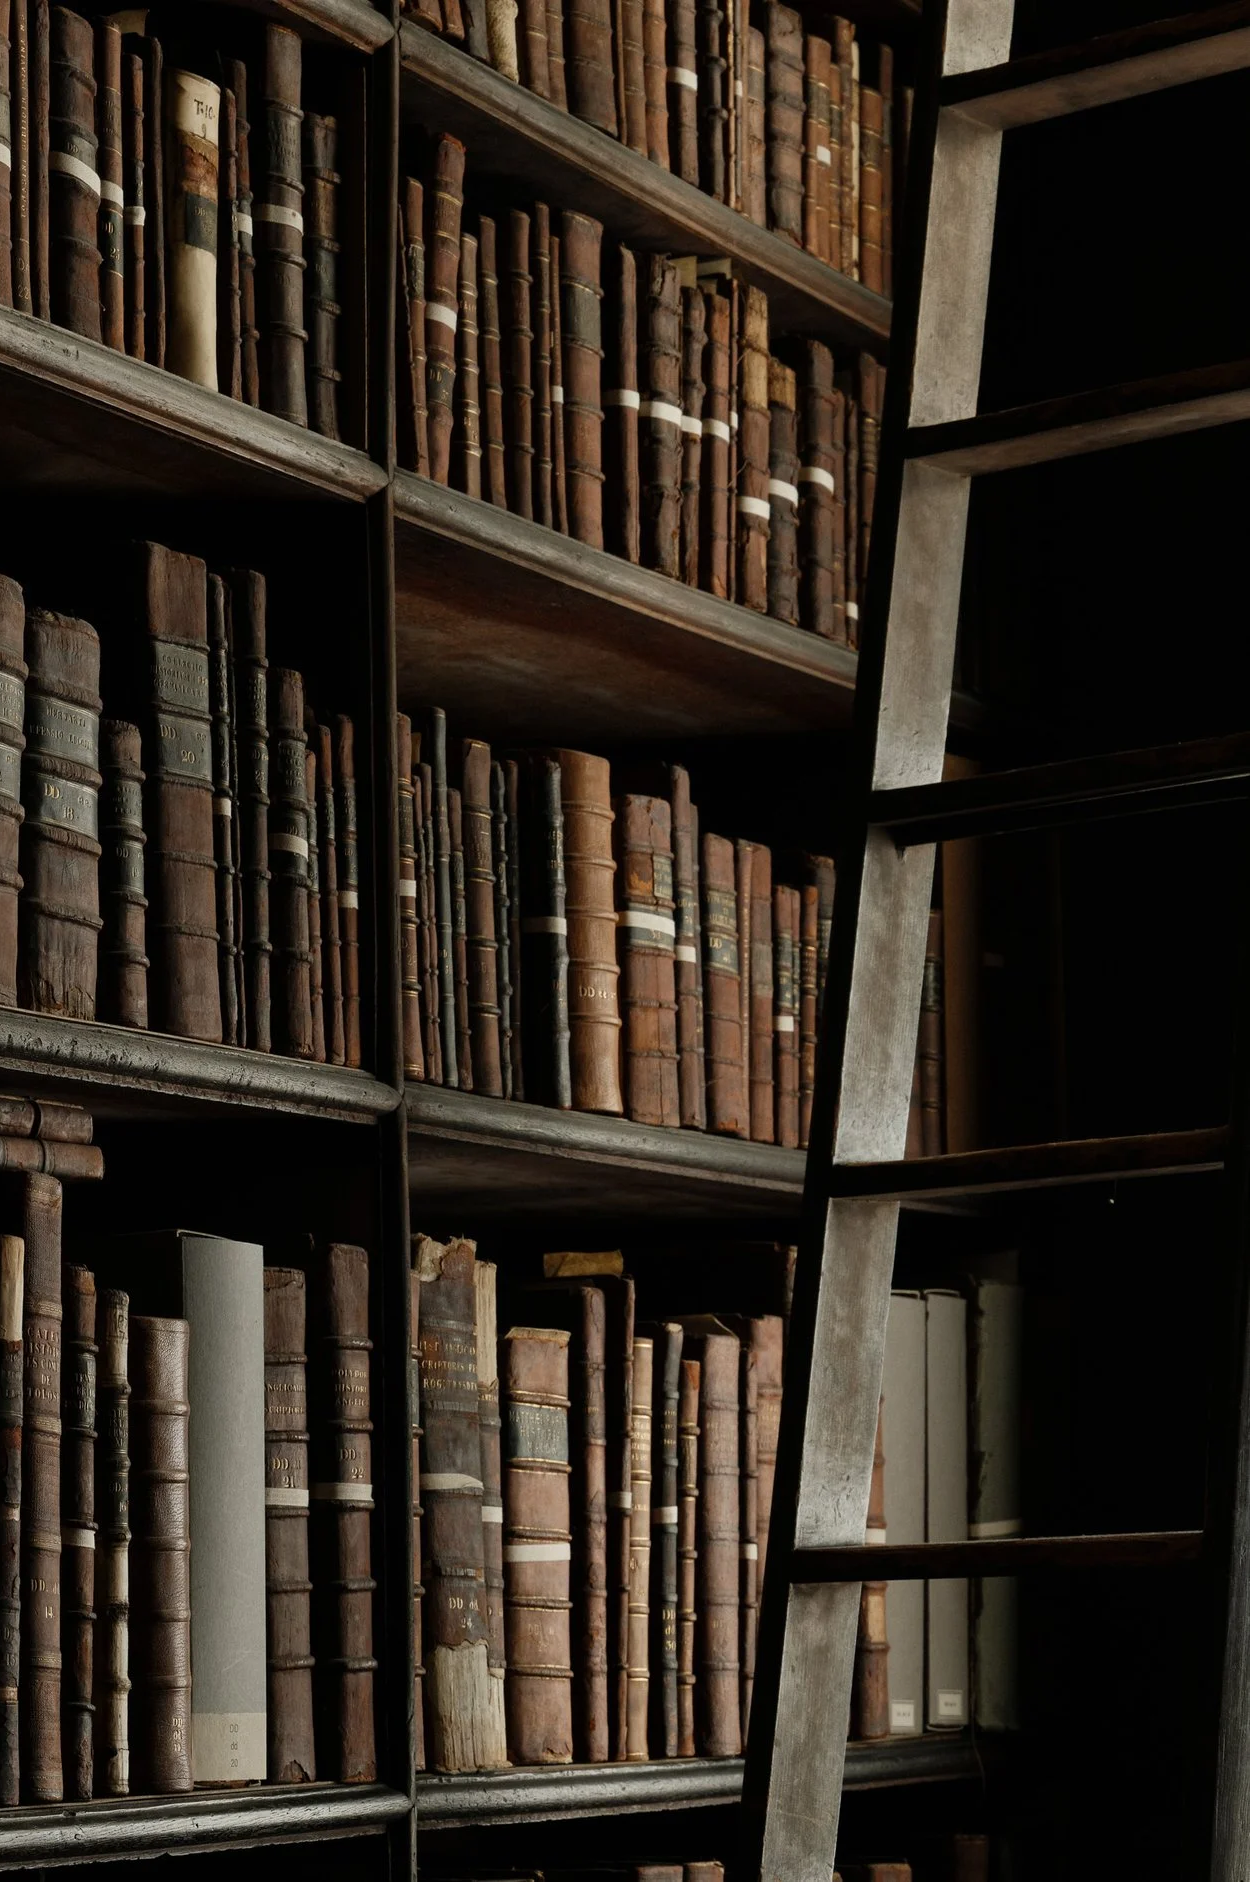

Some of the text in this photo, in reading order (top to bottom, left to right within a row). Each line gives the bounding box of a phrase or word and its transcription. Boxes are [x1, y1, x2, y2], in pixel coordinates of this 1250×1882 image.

[41, 1373, 52, 1386] DE
[351, 1467, 365, 1479] 22
[230, 1758, 239, 1768] 20
